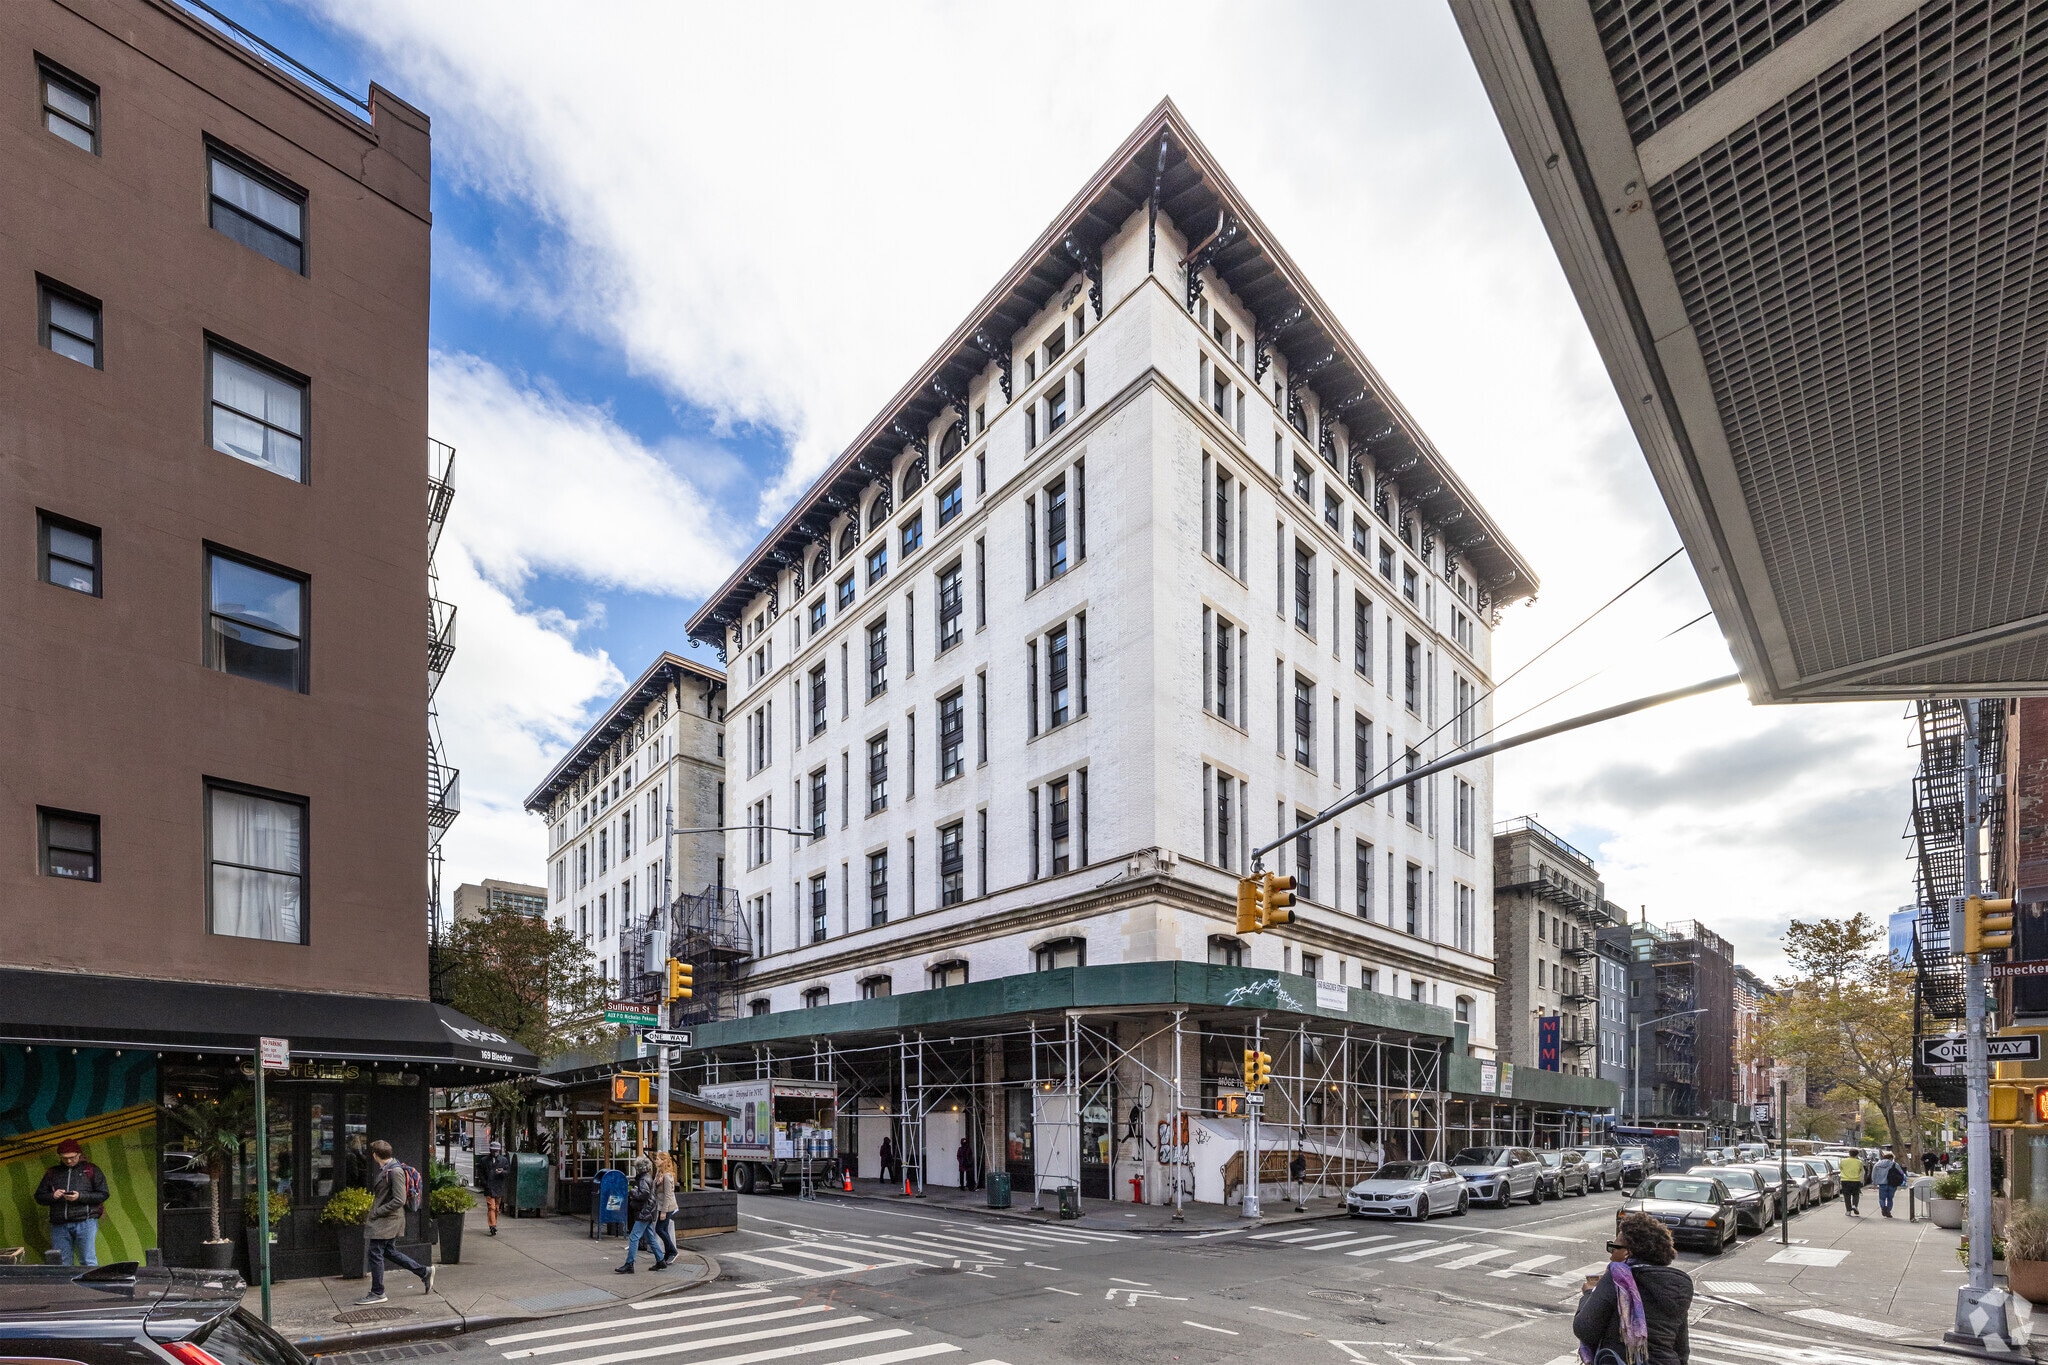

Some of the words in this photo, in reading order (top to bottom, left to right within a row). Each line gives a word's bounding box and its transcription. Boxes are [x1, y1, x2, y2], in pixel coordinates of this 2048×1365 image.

[607, 1002, 639, 1013] Sullivan
[642, 1005, 650, 1014] St
[624, 1013, 641, 1021] Nicholas
[1941, 1045, 1967, 1056] ONE
[1988, 1042, 2022, 1054] WAY
[481, 1050, 491, 1060] 169
[491, 1052, 513, 1063] Bleecker
[753, 1088, 763, 1096] NYC
